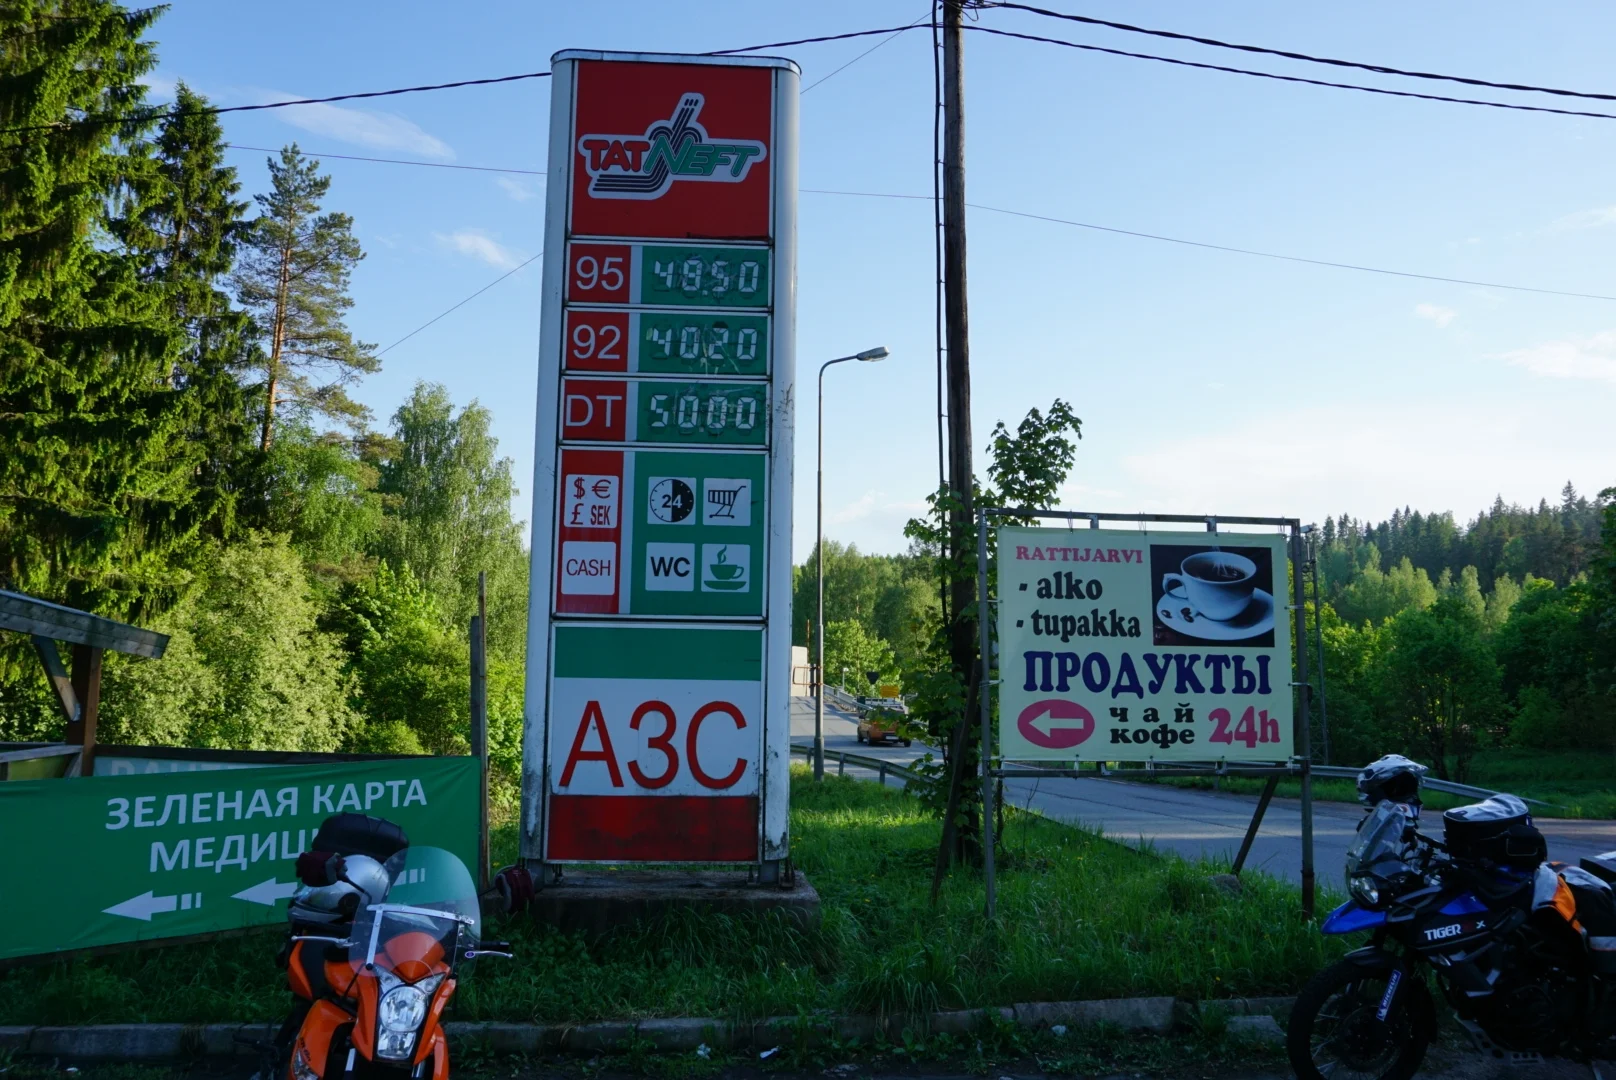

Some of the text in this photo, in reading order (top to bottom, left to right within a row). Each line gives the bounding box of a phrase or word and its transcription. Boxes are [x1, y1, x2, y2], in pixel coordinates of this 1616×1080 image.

[576, 255, 624, 290] 95
[573, 324, 621, 359] 92
[565, 394, 622, 427] DT
[590, 505, 611, 526] SEK
[662, 494, 682, 509] 24
[566, 558, 611, 576] CASH
[650, 556, 691, 577] WC
[1016, 546, 1143, 564] RATTIJARVI
[1036, 571, 1103, 600] alko
[1031, 608, 1141, 643] tupakka
[1023, 650, 1272, 699] ПРОДУКТЫ
[1109, 724, 1195, 749] кофе
[1208, 706, 1281, 748] 24h
[558, 700, 748, 789] АЗС
[105, 778, 428, 830] ЗЕЛЕНАЯ КАРТА
[149, 827, 319, 873] МЕДИЦ
[1424, 923, 1462, 940] TIGER
